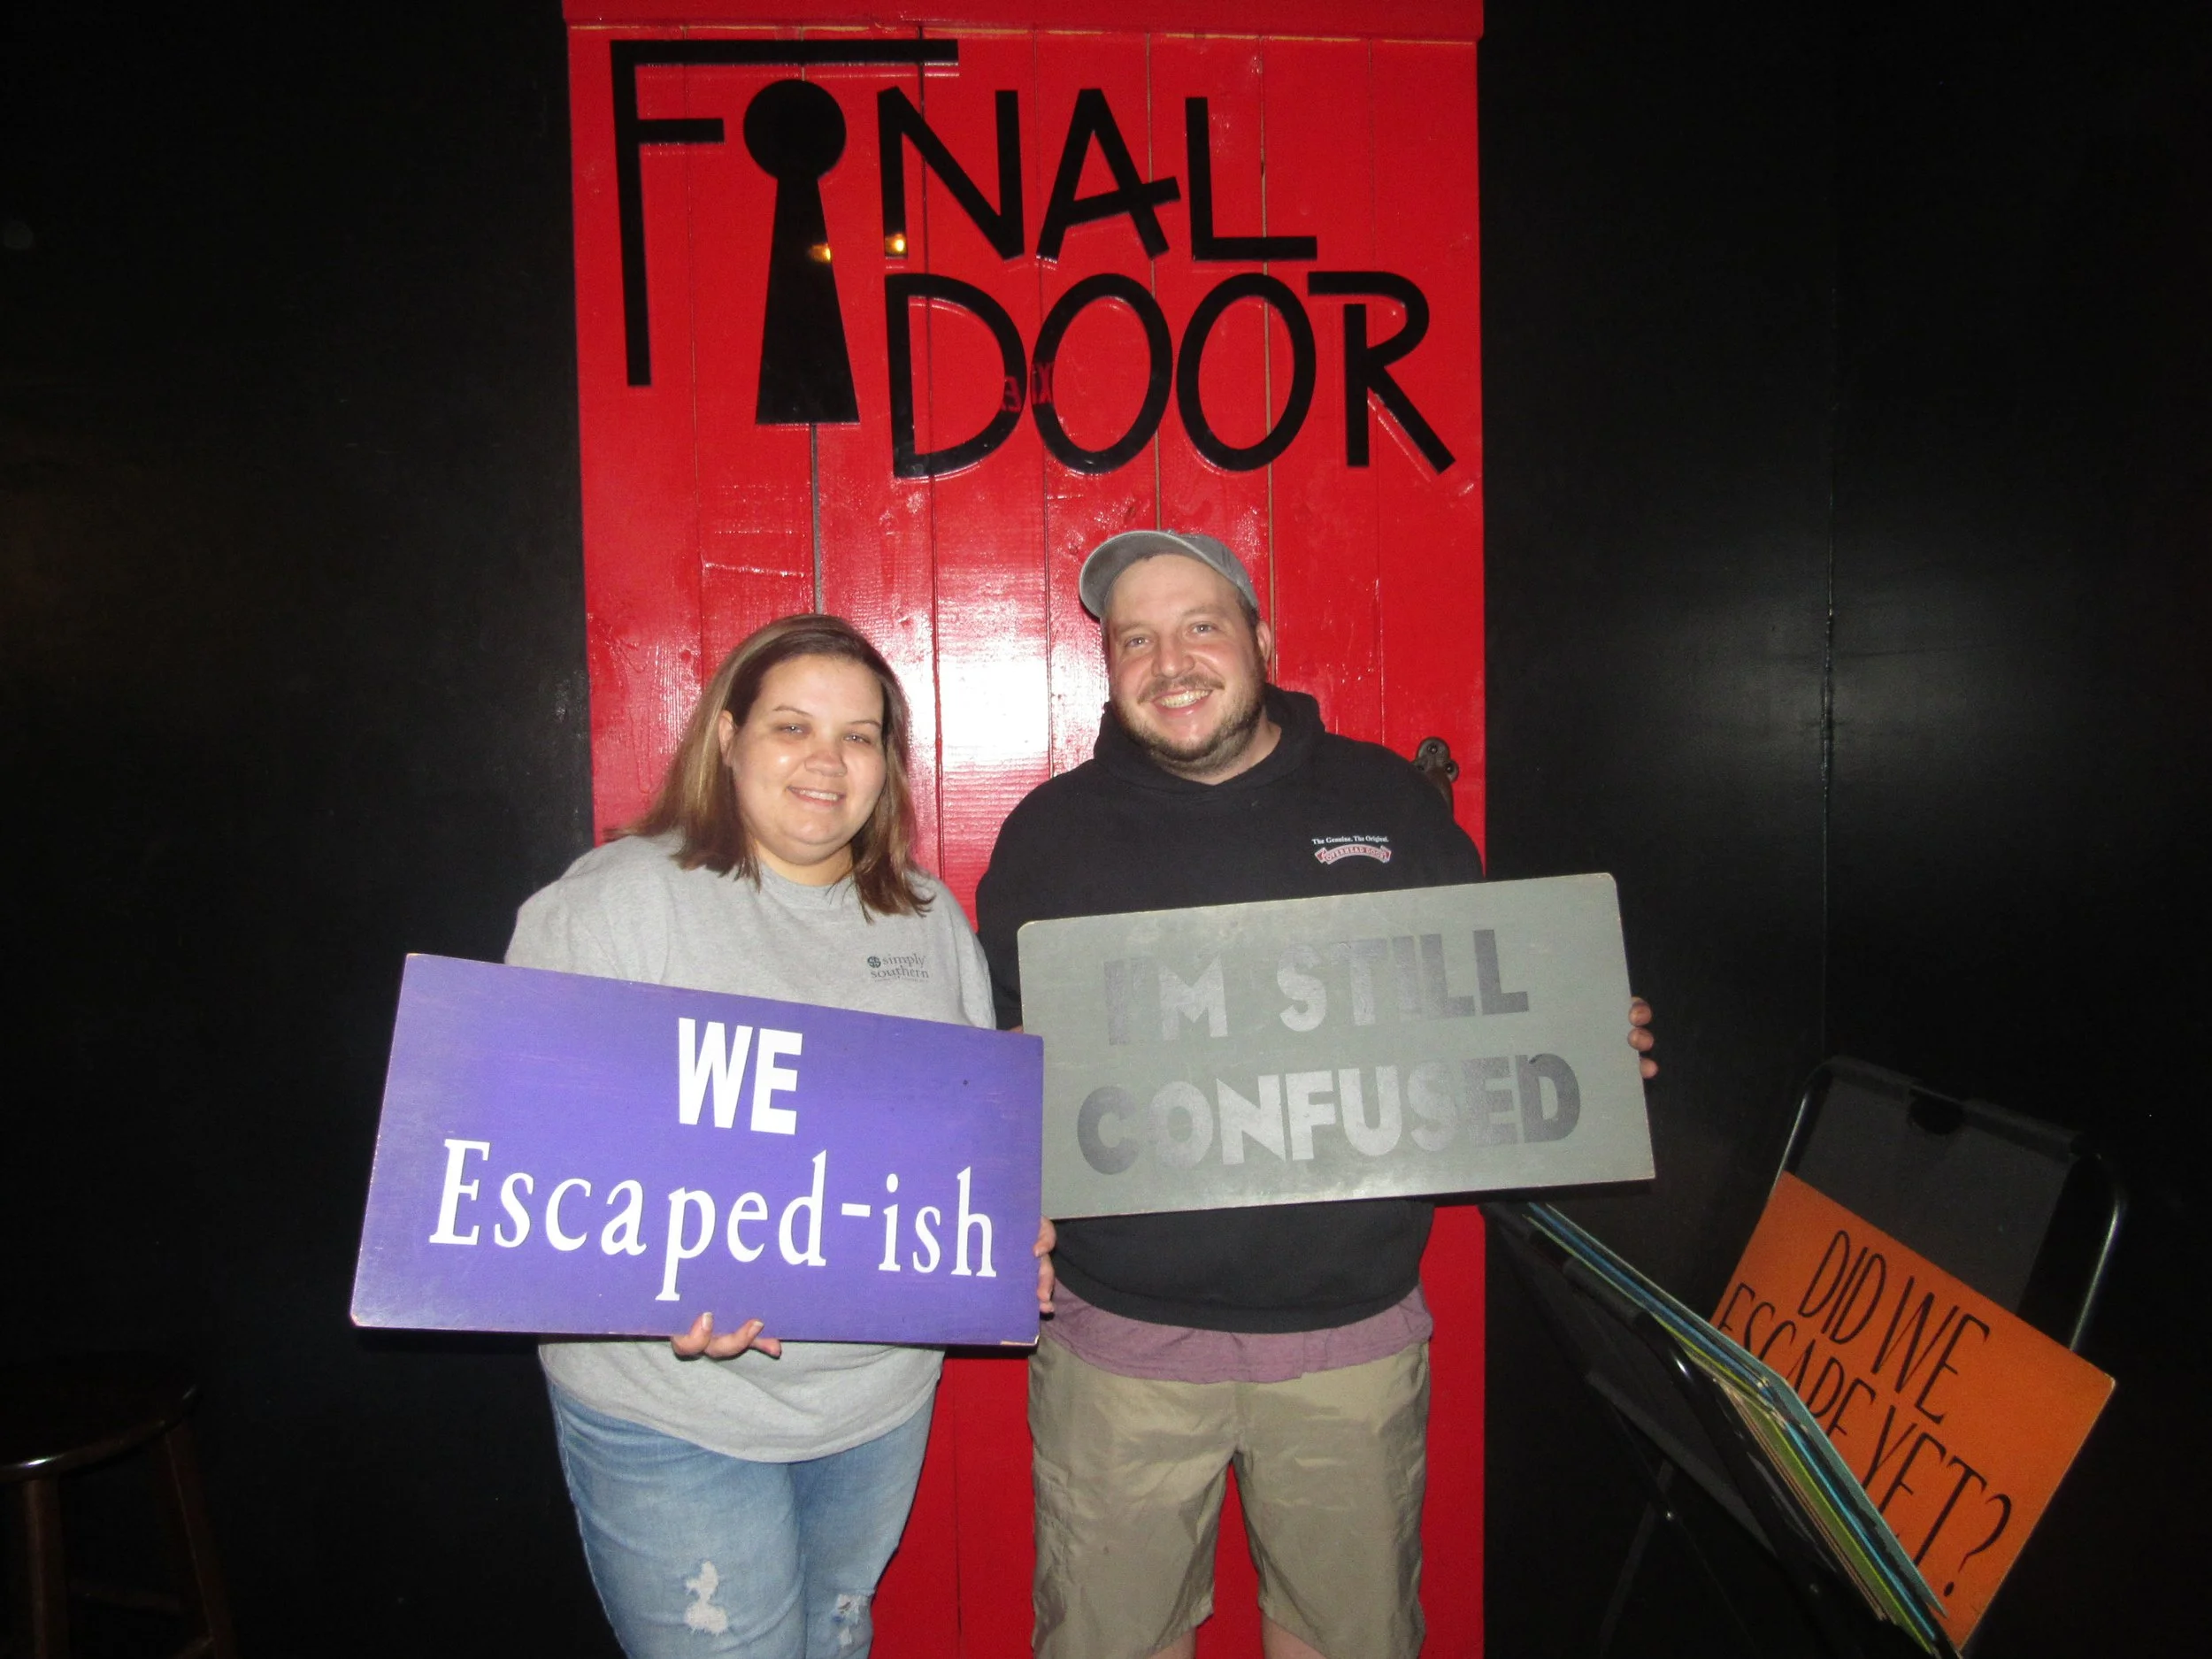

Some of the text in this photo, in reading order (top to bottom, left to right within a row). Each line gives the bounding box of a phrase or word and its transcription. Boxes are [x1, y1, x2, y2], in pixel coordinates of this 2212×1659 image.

[611, 39, 1317, 425] FINAL
[886, 271, 1455, 479] DOOR
[871, 964, 929, 979] southern
[882, 953, 926, 968] simply
[1103, 929, 1529, 1046] I'M STILL
[678, 1018, 804, 1135] WE
[1077, 1053, 1581, 1175] CONFUSED
[428, 1148, 997, 1302] Escaped-ish
[1798, 1230, 1991, 1425] DID WE
[1861, 1403, 2012, 1598] YET?
